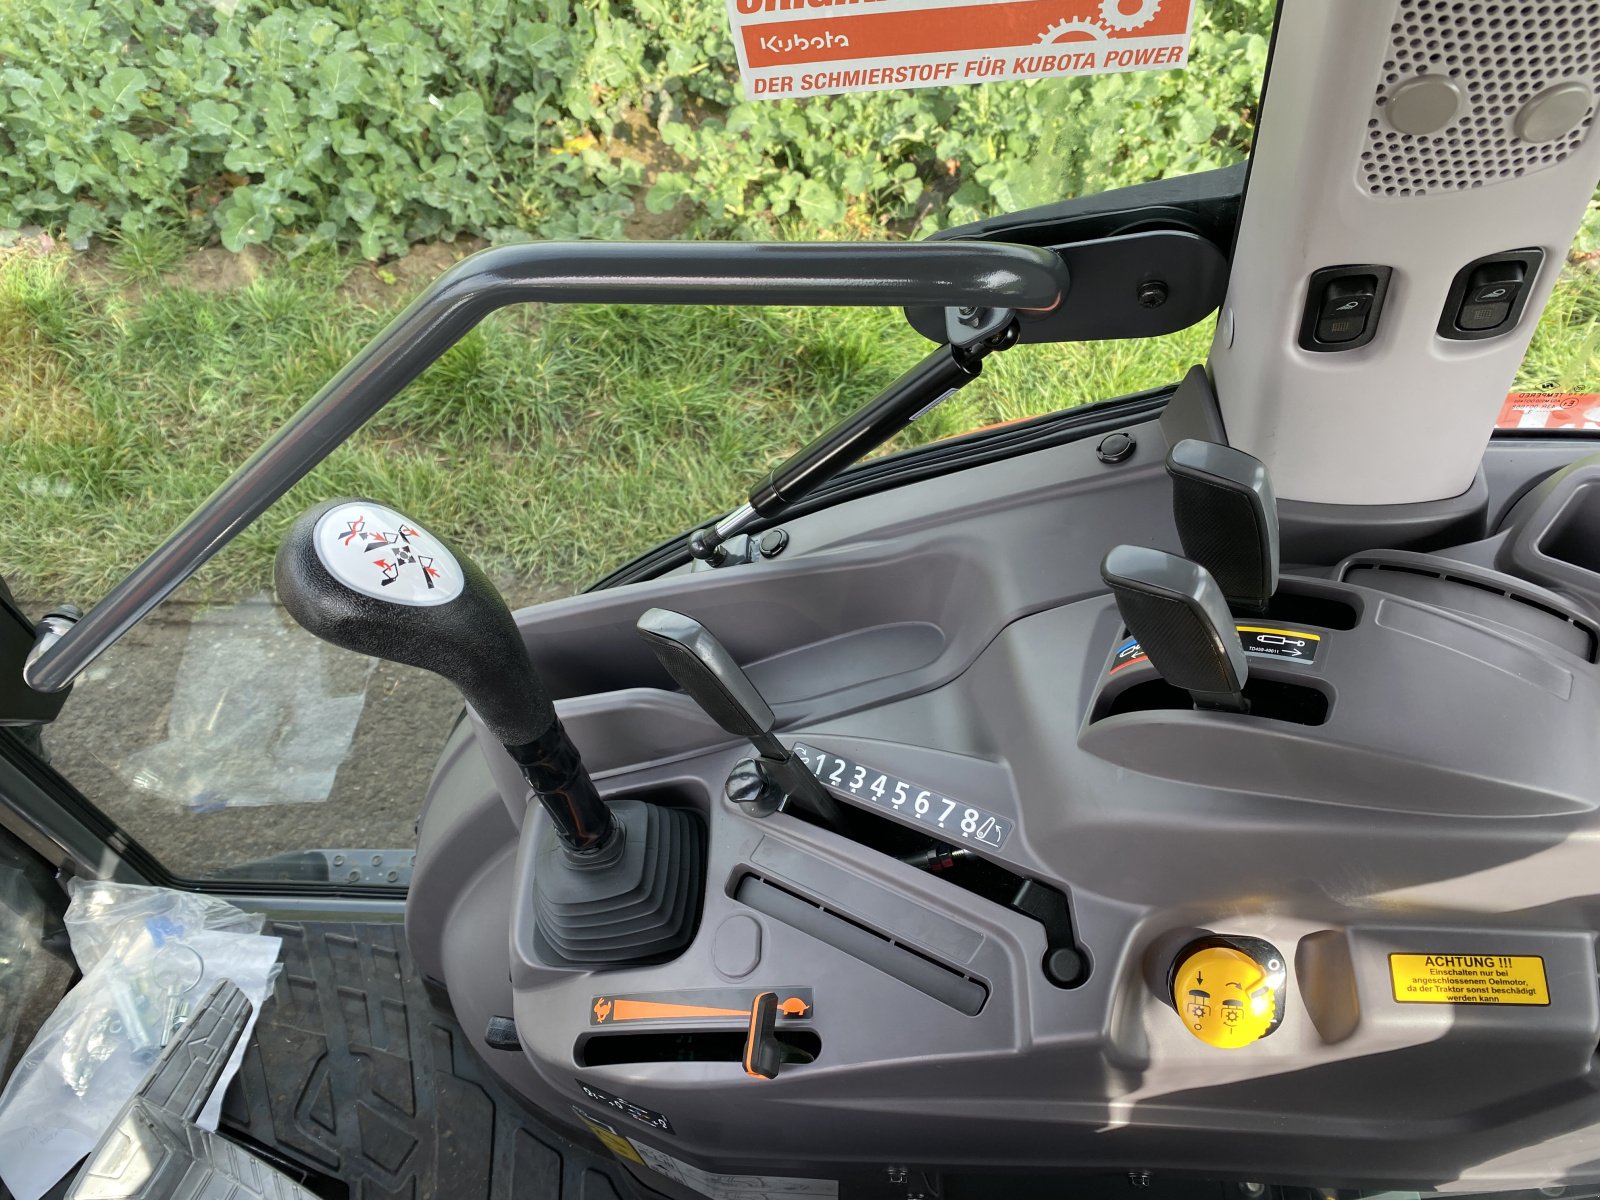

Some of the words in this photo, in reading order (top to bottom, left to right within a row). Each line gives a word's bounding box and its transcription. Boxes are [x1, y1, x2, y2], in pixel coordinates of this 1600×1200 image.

[760, 31, 849, 53] Kubota
[754, 76, 793, 94] DER
[800, 62, 959, 91] SCHMIERSTOFF
[964, 56, 1007, 77] FÜR
[1012, 52, 1096, 74] KUBOTA
[1103, 46, 1184, 67] POWER
[1425, 956, 1495, 968] ACHTUNG
[1430, 968, 1478, 976] Einschalten
[1495, 969, 1509, 977] bei
[1412, 977, 1487, 985] angeschlossenem
[1434, 985, 1464, 993] Traktor
[1491, 986, 1537, 996] beschädigt
[1447, 994, 1477, 1002] werden
[1479, 994, 1500, 1002] kann
